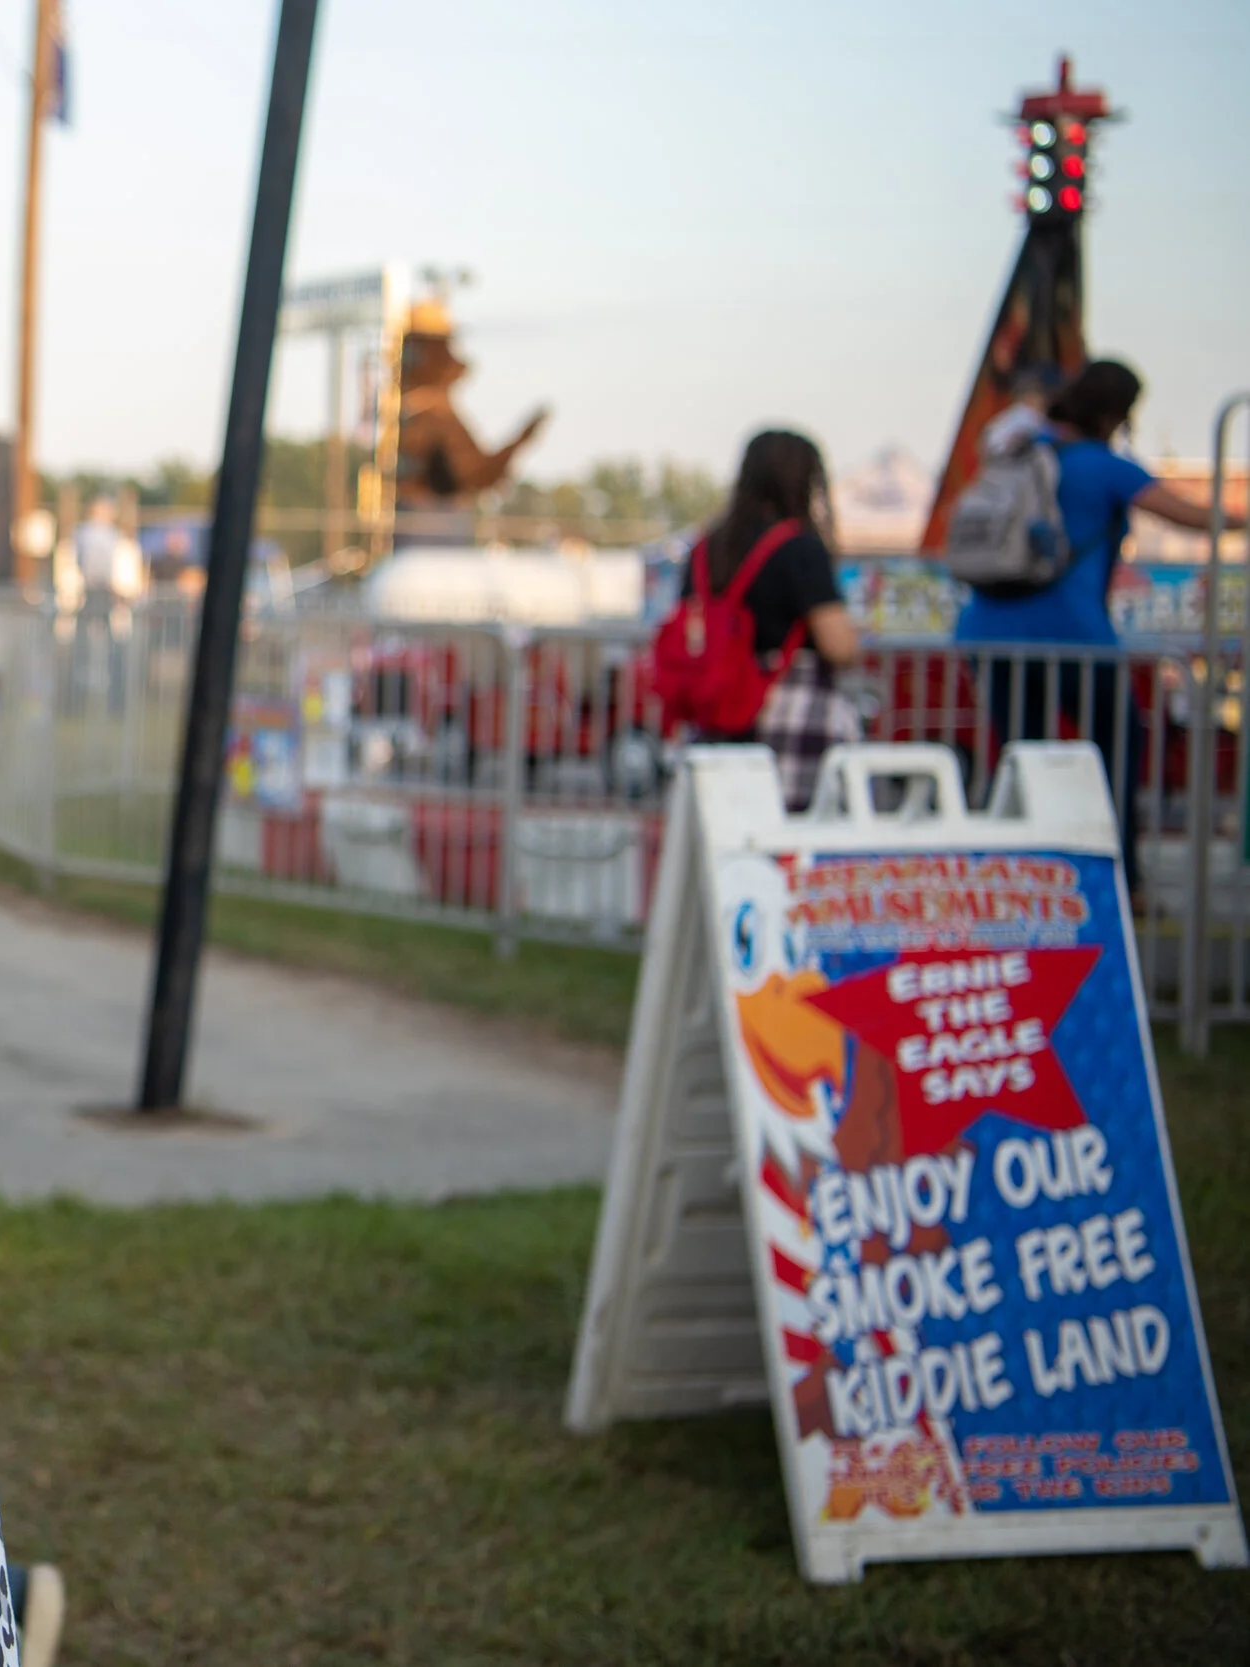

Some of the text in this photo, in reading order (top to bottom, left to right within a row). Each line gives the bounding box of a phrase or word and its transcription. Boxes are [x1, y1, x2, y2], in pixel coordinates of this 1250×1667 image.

[777, 854, 1082, 890] DREAMLAND
[784, 888, 1091, 923] AMUSEMENTS
[887, 950, 1031, 1003] ERNIE
[915, 988, 1014, 1033] THE
[897, 1017, 1047, 1073] EAGLE
[921, 1056, 1037, 1105] SAYS
[813, 1123, 1114, 1249] ENJOY OUR
[807, 1207, 1155, 1341] SMOKE FREE
[825, 1304, 1170, 1438] KIDDIE LAND
[964, 1434, 1100, 1456] FOLLOW
[1113, 1428, 1188, 1453] OUR
[1054, 1451, 1199, 1475] POLICIES
[1013, 1477, 1082, 1500] THE
[1093, 1473, 1171, 1497] KIDS
